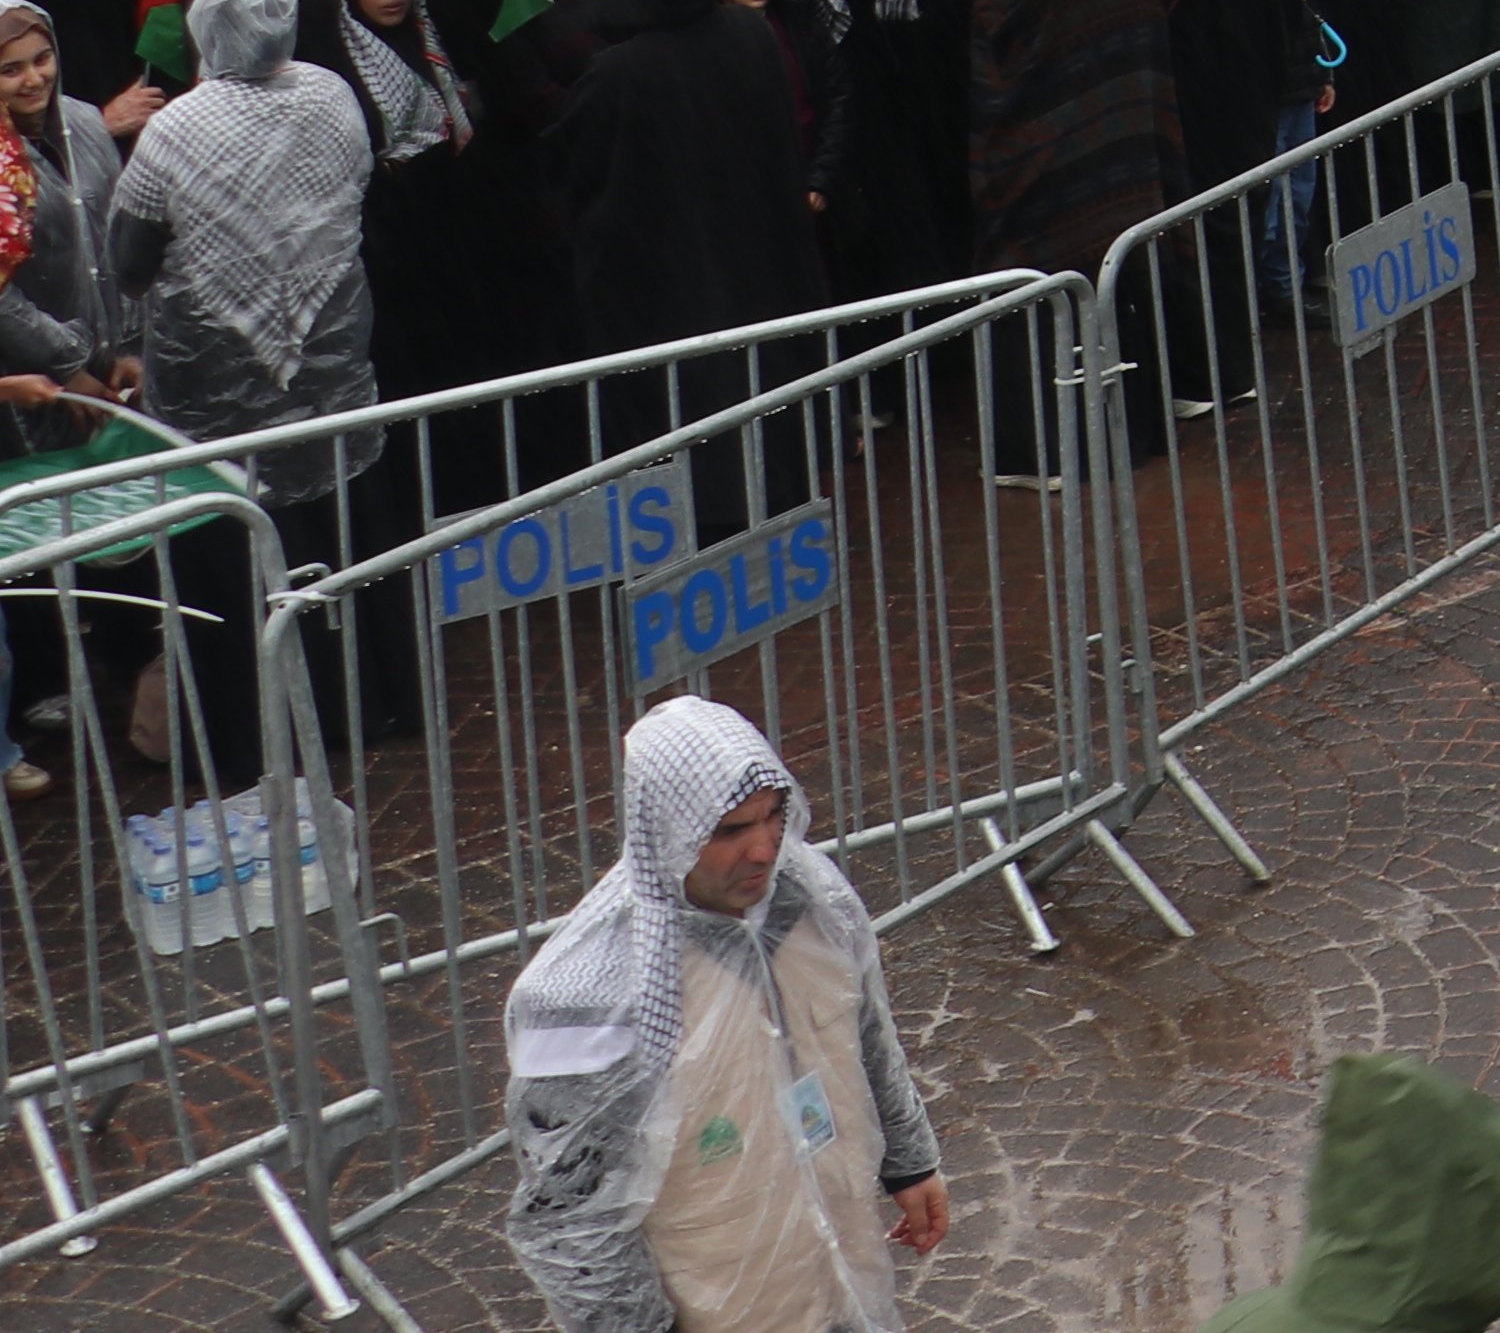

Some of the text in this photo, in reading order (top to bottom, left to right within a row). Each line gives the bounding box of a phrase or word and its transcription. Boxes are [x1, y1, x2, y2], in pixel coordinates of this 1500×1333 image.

[1348, 209, 1463, 334] POLİS
[440, 484, 676, 617] POLİS
[633, 518, 833, 681] POLİS
